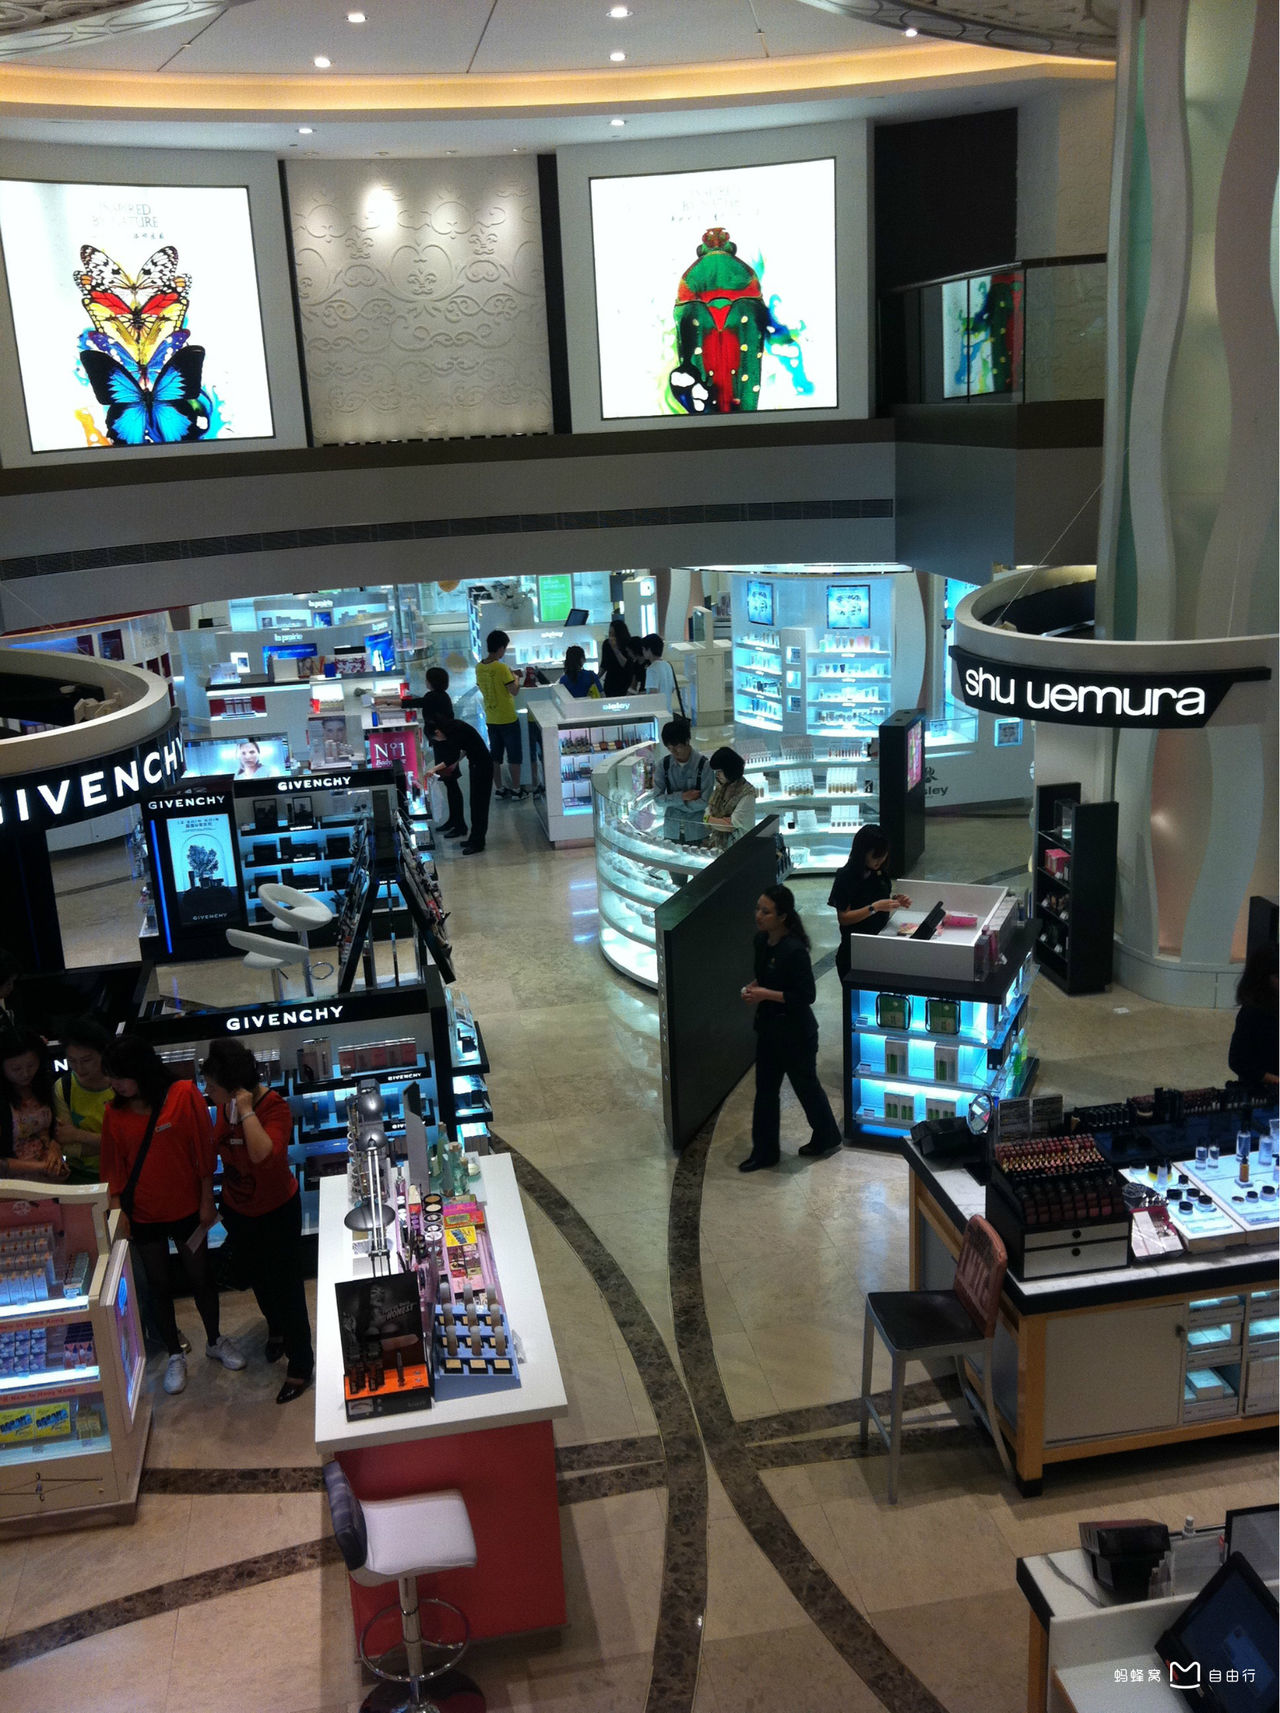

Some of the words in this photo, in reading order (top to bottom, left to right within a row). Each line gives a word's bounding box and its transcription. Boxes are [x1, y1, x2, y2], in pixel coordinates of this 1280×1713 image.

[965, 667, 1015, 705] shu
[1026, 681, 1206, 716] uemura
[0, 736, 184, 826] IVENCHY
[277, 776, 352, 791] GIVENCHY
[148, 795, 225, 810] GIVENCHY
[192, 912, 228, 921] GIVENCHY
[226, 1005, 344, 1031] GIVENCHY
[387, 1073, 422, 1081] GIVENCHY
